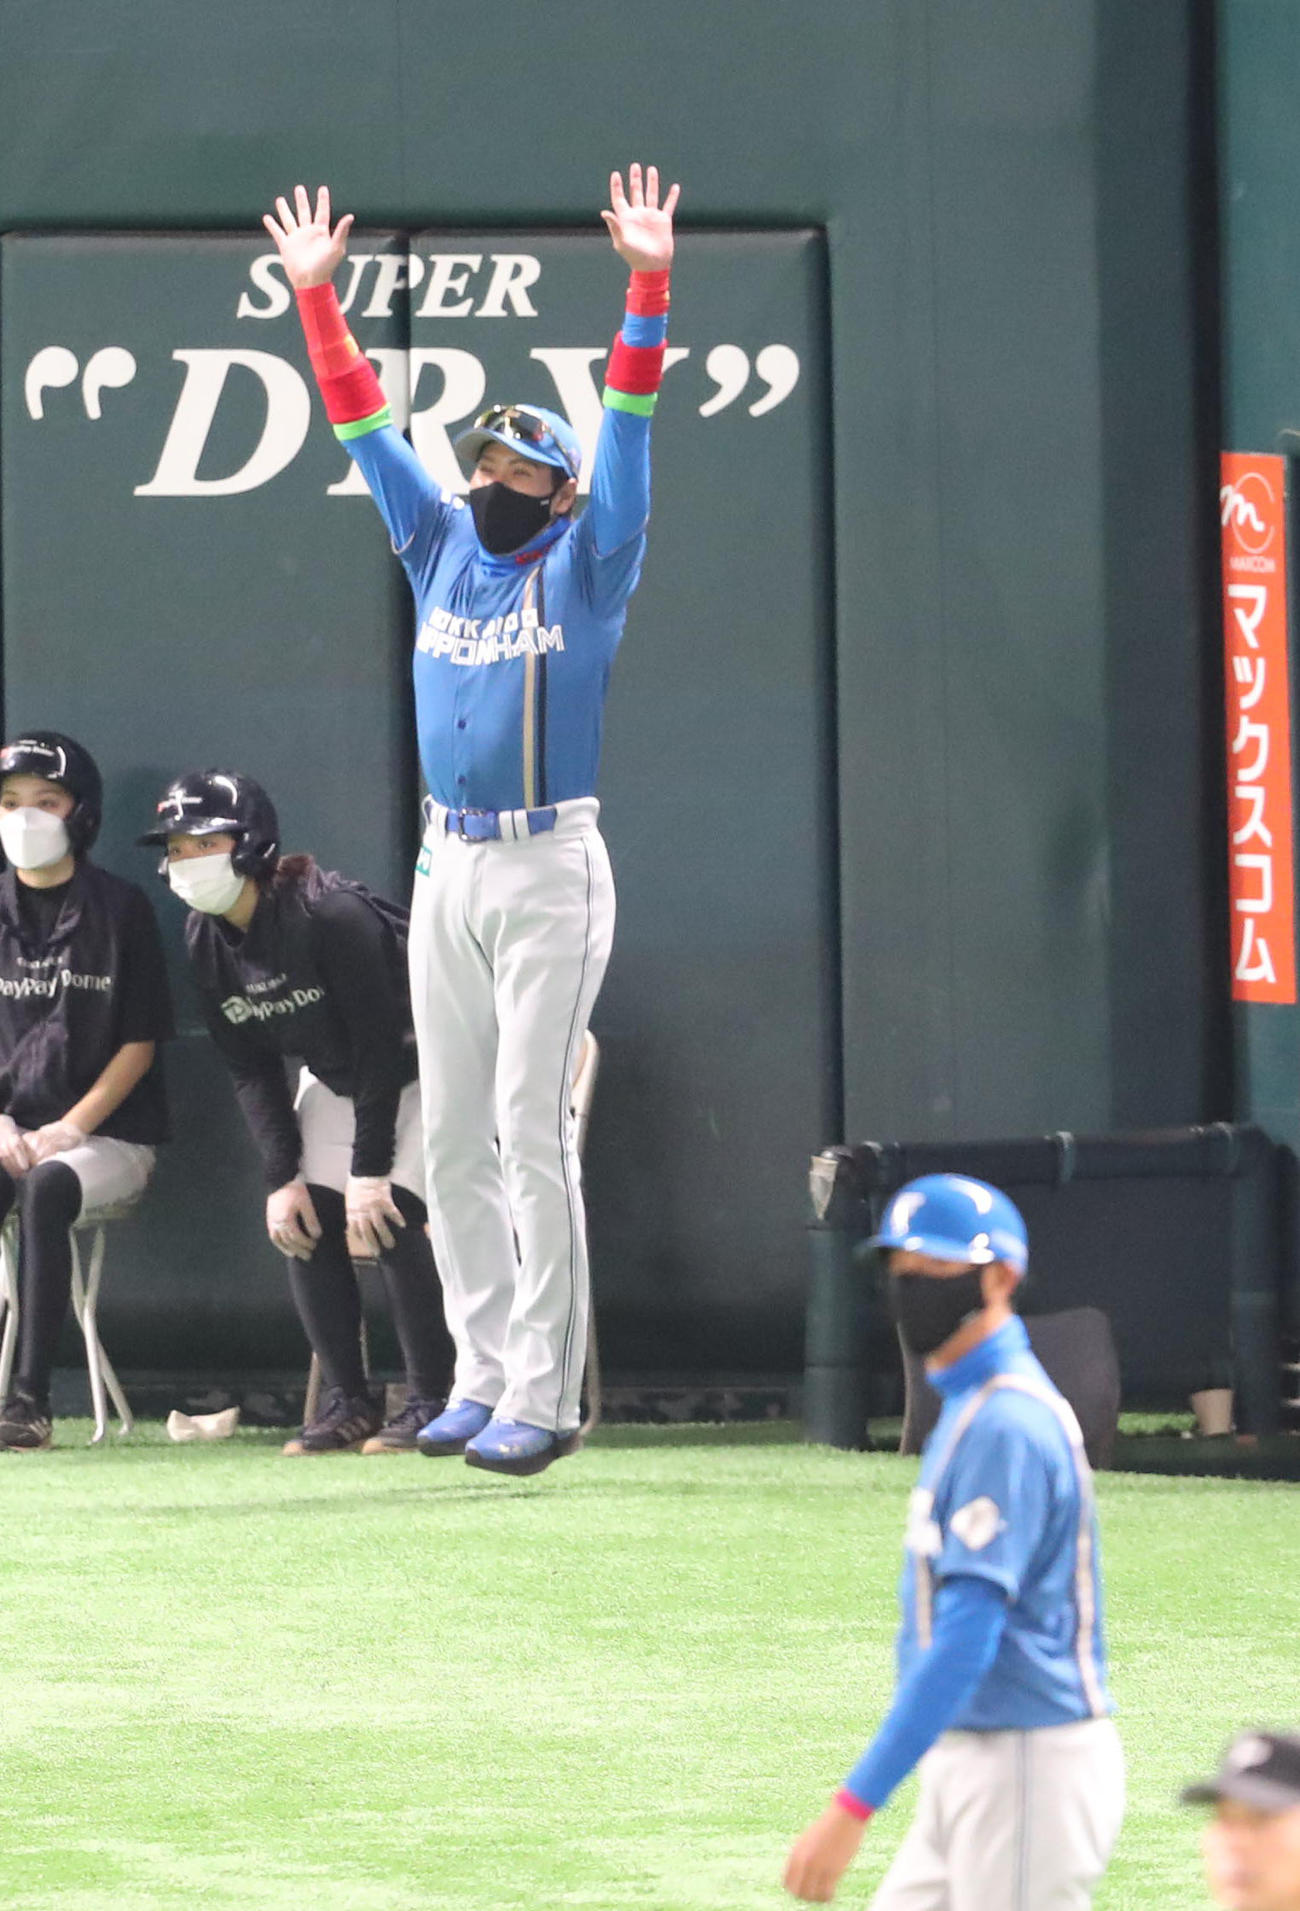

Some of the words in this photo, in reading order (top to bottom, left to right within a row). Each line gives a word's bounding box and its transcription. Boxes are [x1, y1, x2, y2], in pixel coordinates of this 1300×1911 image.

[1227, 583, 1278, 985] マックスコム
[61, 969, 112, 991] Dome
